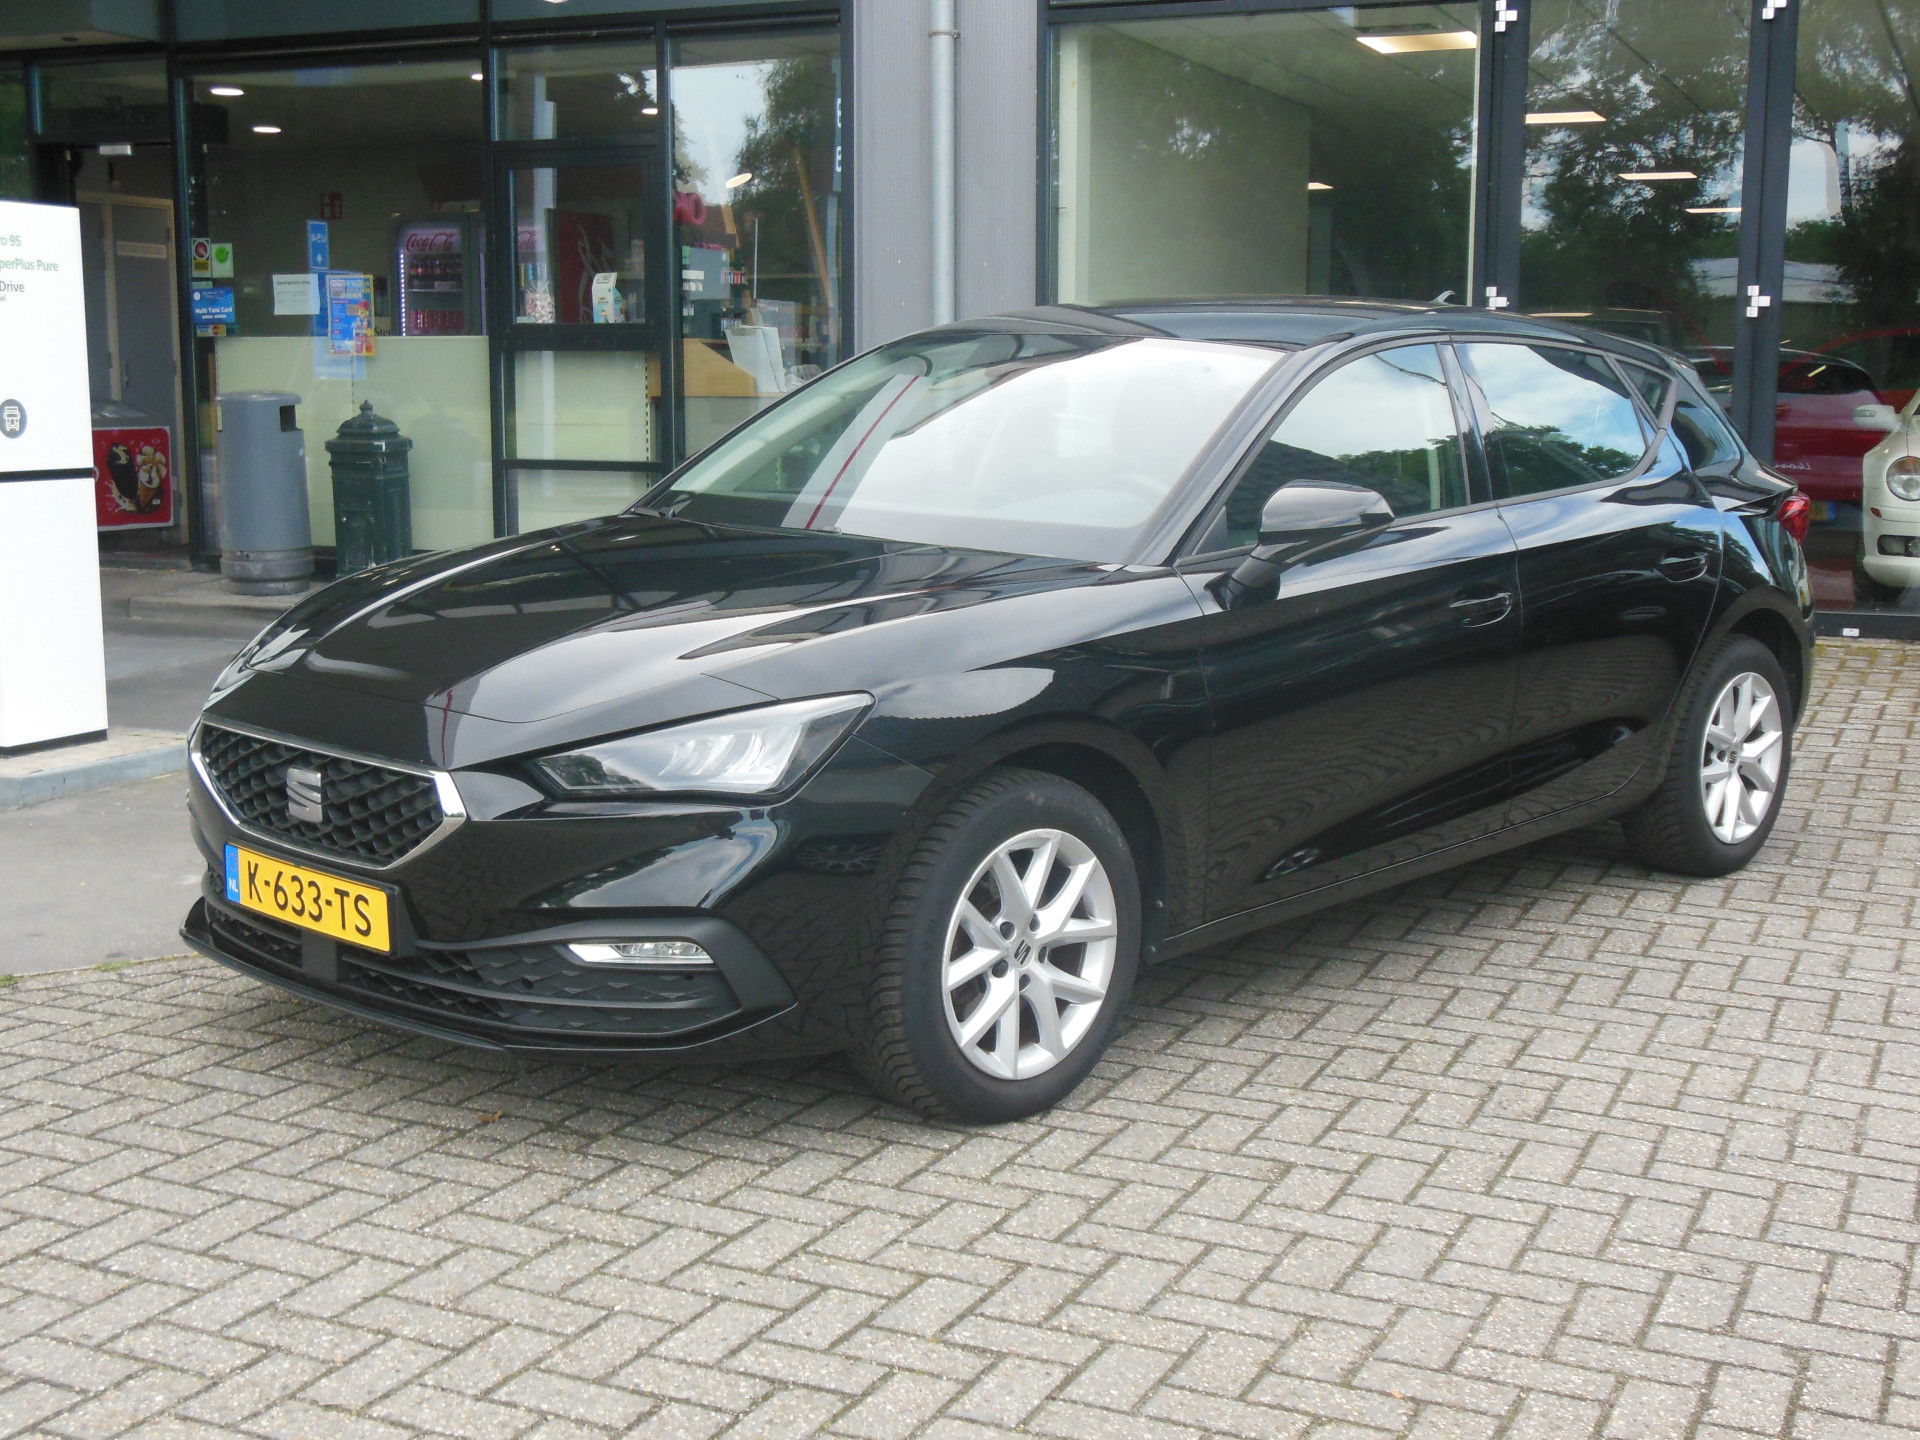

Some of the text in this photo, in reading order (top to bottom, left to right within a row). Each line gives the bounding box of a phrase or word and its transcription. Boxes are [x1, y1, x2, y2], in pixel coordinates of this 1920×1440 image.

[9, 235, 22, 248] 95
[36, 259, 59, 272] Pure
[0, 280, 25, 293] Drive
[228, 878, 239, 893] NL
[247, 860, 372, 937] K-633-TS
